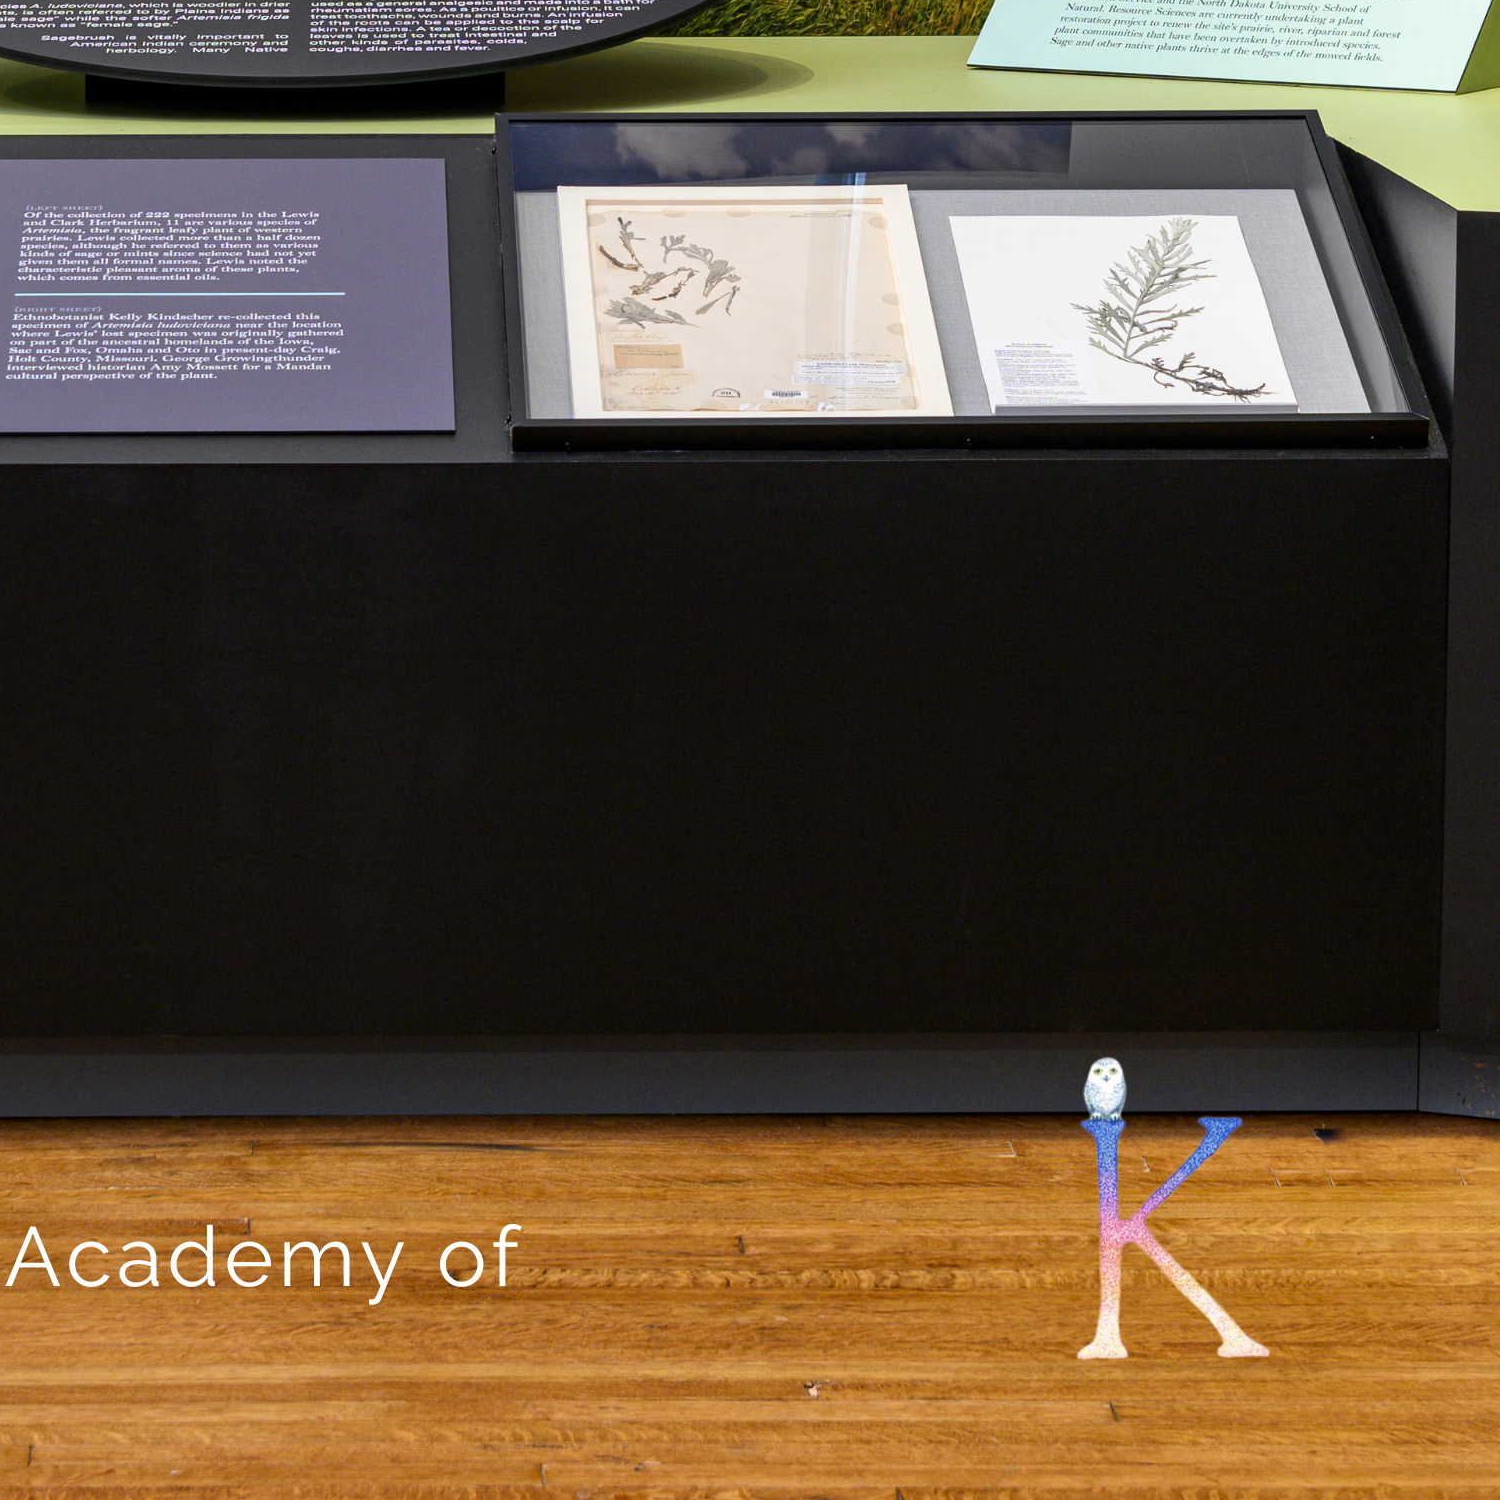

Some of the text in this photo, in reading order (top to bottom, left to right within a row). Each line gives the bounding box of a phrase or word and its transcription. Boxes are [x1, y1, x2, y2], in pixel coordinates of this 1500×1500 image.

[174, 211, 237, 219] specimens
[208, 218, 253, 226] various
[257, 218, 300, 227] species
[109, 313, 143, 322] Kelly
